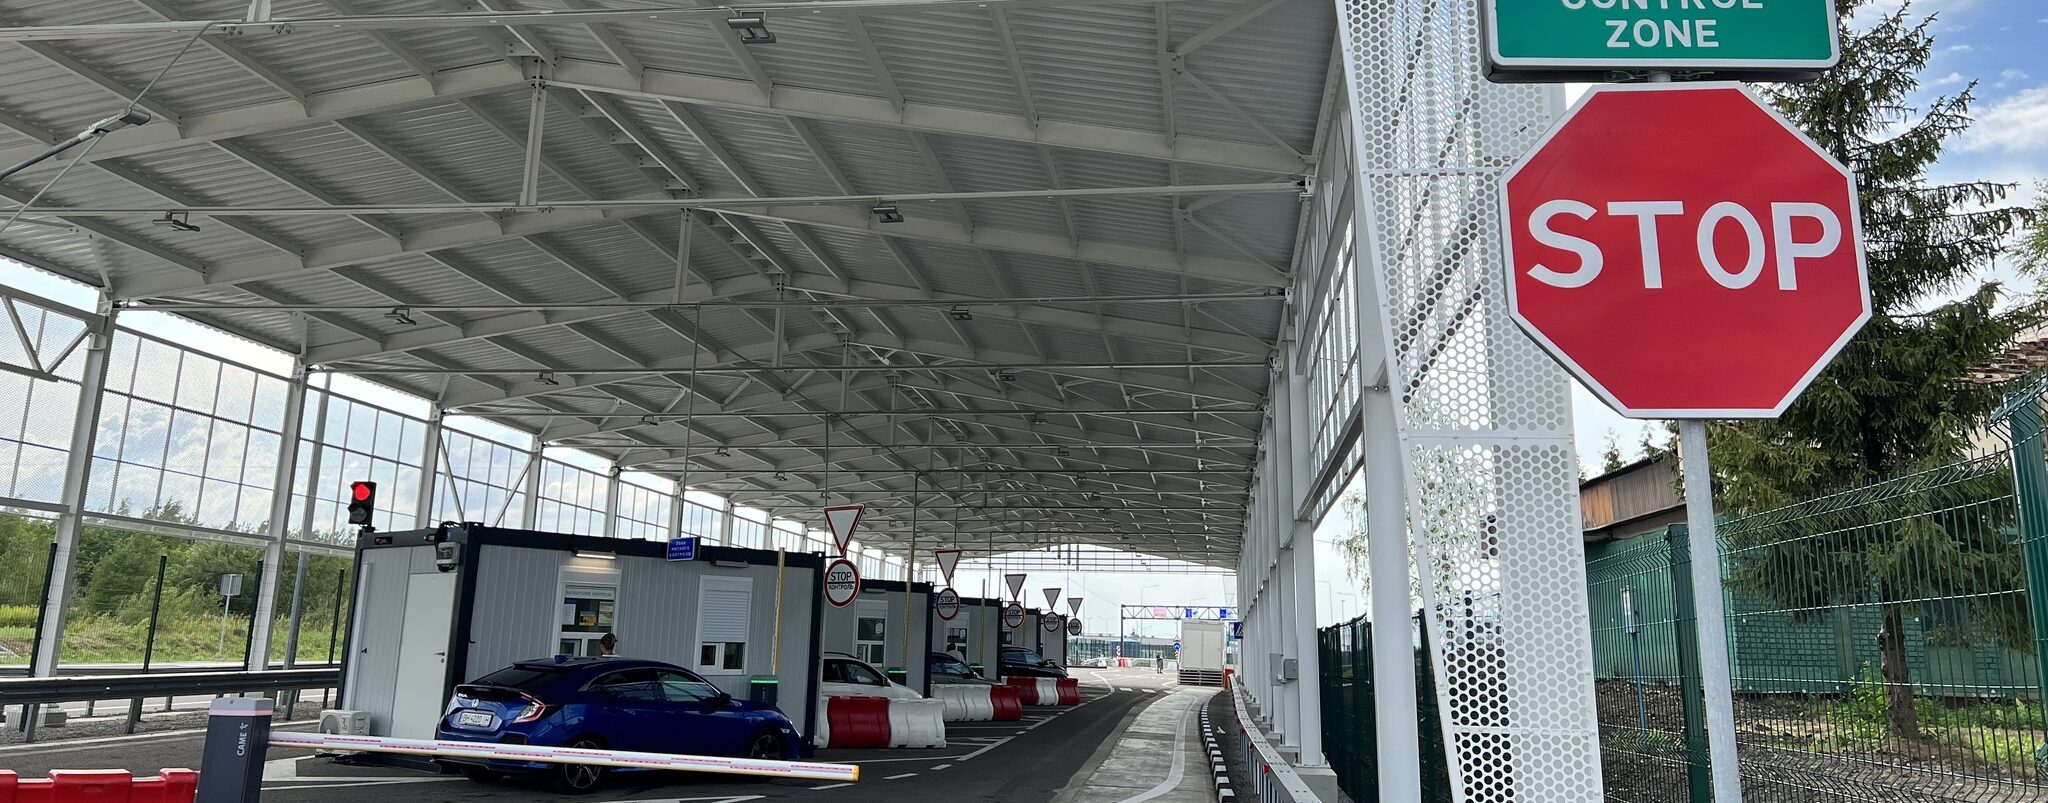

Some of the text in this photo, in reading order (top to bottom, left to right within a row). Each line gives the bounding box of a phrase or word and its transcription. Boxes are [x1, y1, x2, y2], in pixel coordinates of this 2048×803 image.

[1605, 19, 1719, 48] ZONE
[1527, 199, 1842, 291] STOP
[830, 571, 852, 582] STOP
[940, 595, 955, 603] STOP
[236, 732, 248, 756] CAME
